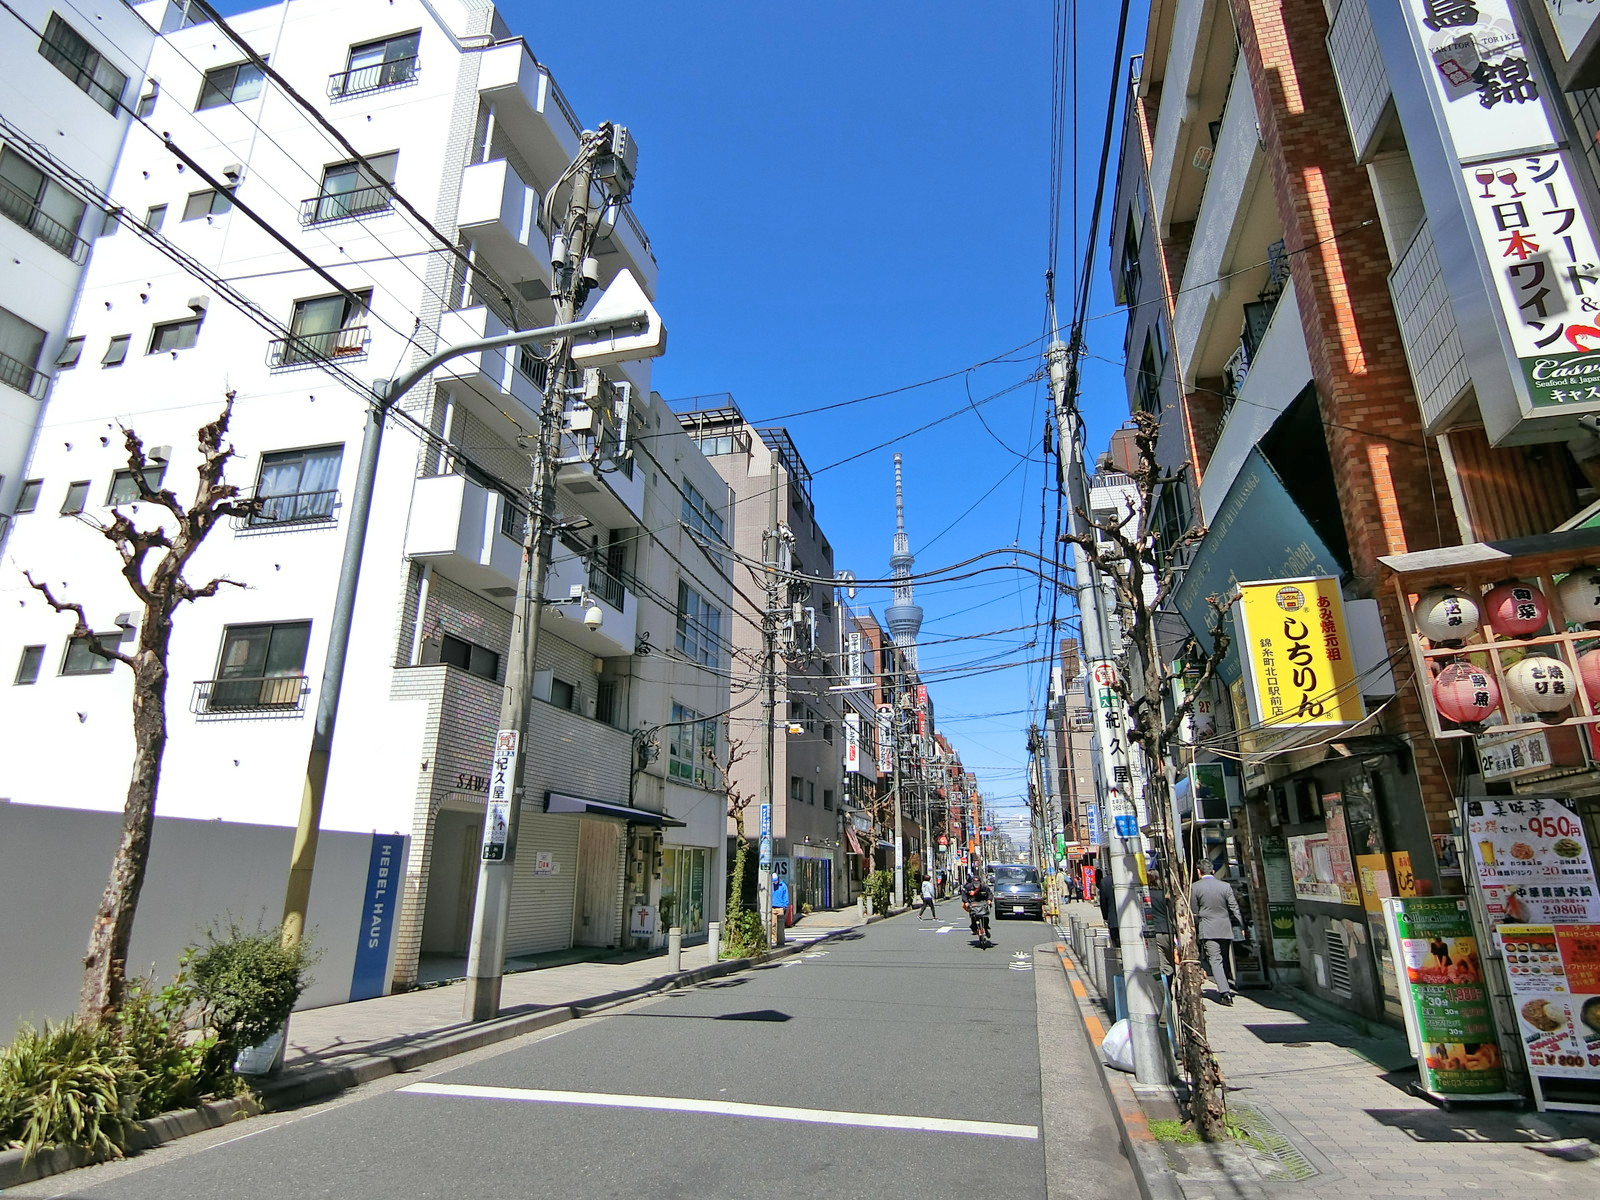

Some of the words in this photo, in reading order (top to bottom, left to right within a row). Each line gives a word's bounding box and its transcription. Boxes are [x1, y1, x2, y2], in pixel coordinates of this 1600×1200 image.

[1491, 201, 1564, 349] 日本ワイン
[1535, 378, 1568, 388] Seafood
[1569, 377, 1578, 385] &
[1512, 588, 1538, 620] 旬菜
[1316, 595, 1342, 661] あみ焼元祖
[1259, 638, 1283, 716] 錦糸町北口駅前店
[1284, 616, 1324, 718] しちりん
[1532, 667, 1548, 694] とり
[1548, 665, 1566, 694] 焼き
[1198, 700, 1211, 713] 2F
[1105, 711, 1128, 783] 紀久屋
[1482, 755, 1494, 771] 2F
[493, 757, 509, 799] 紀久屋
[1492, 799, 1546, 816] 美味亭
[1528, 815, 1581, 838] 950円
[375, 845, 392, 899] HEBEL
[368, 903, 384, 949] HAUS
